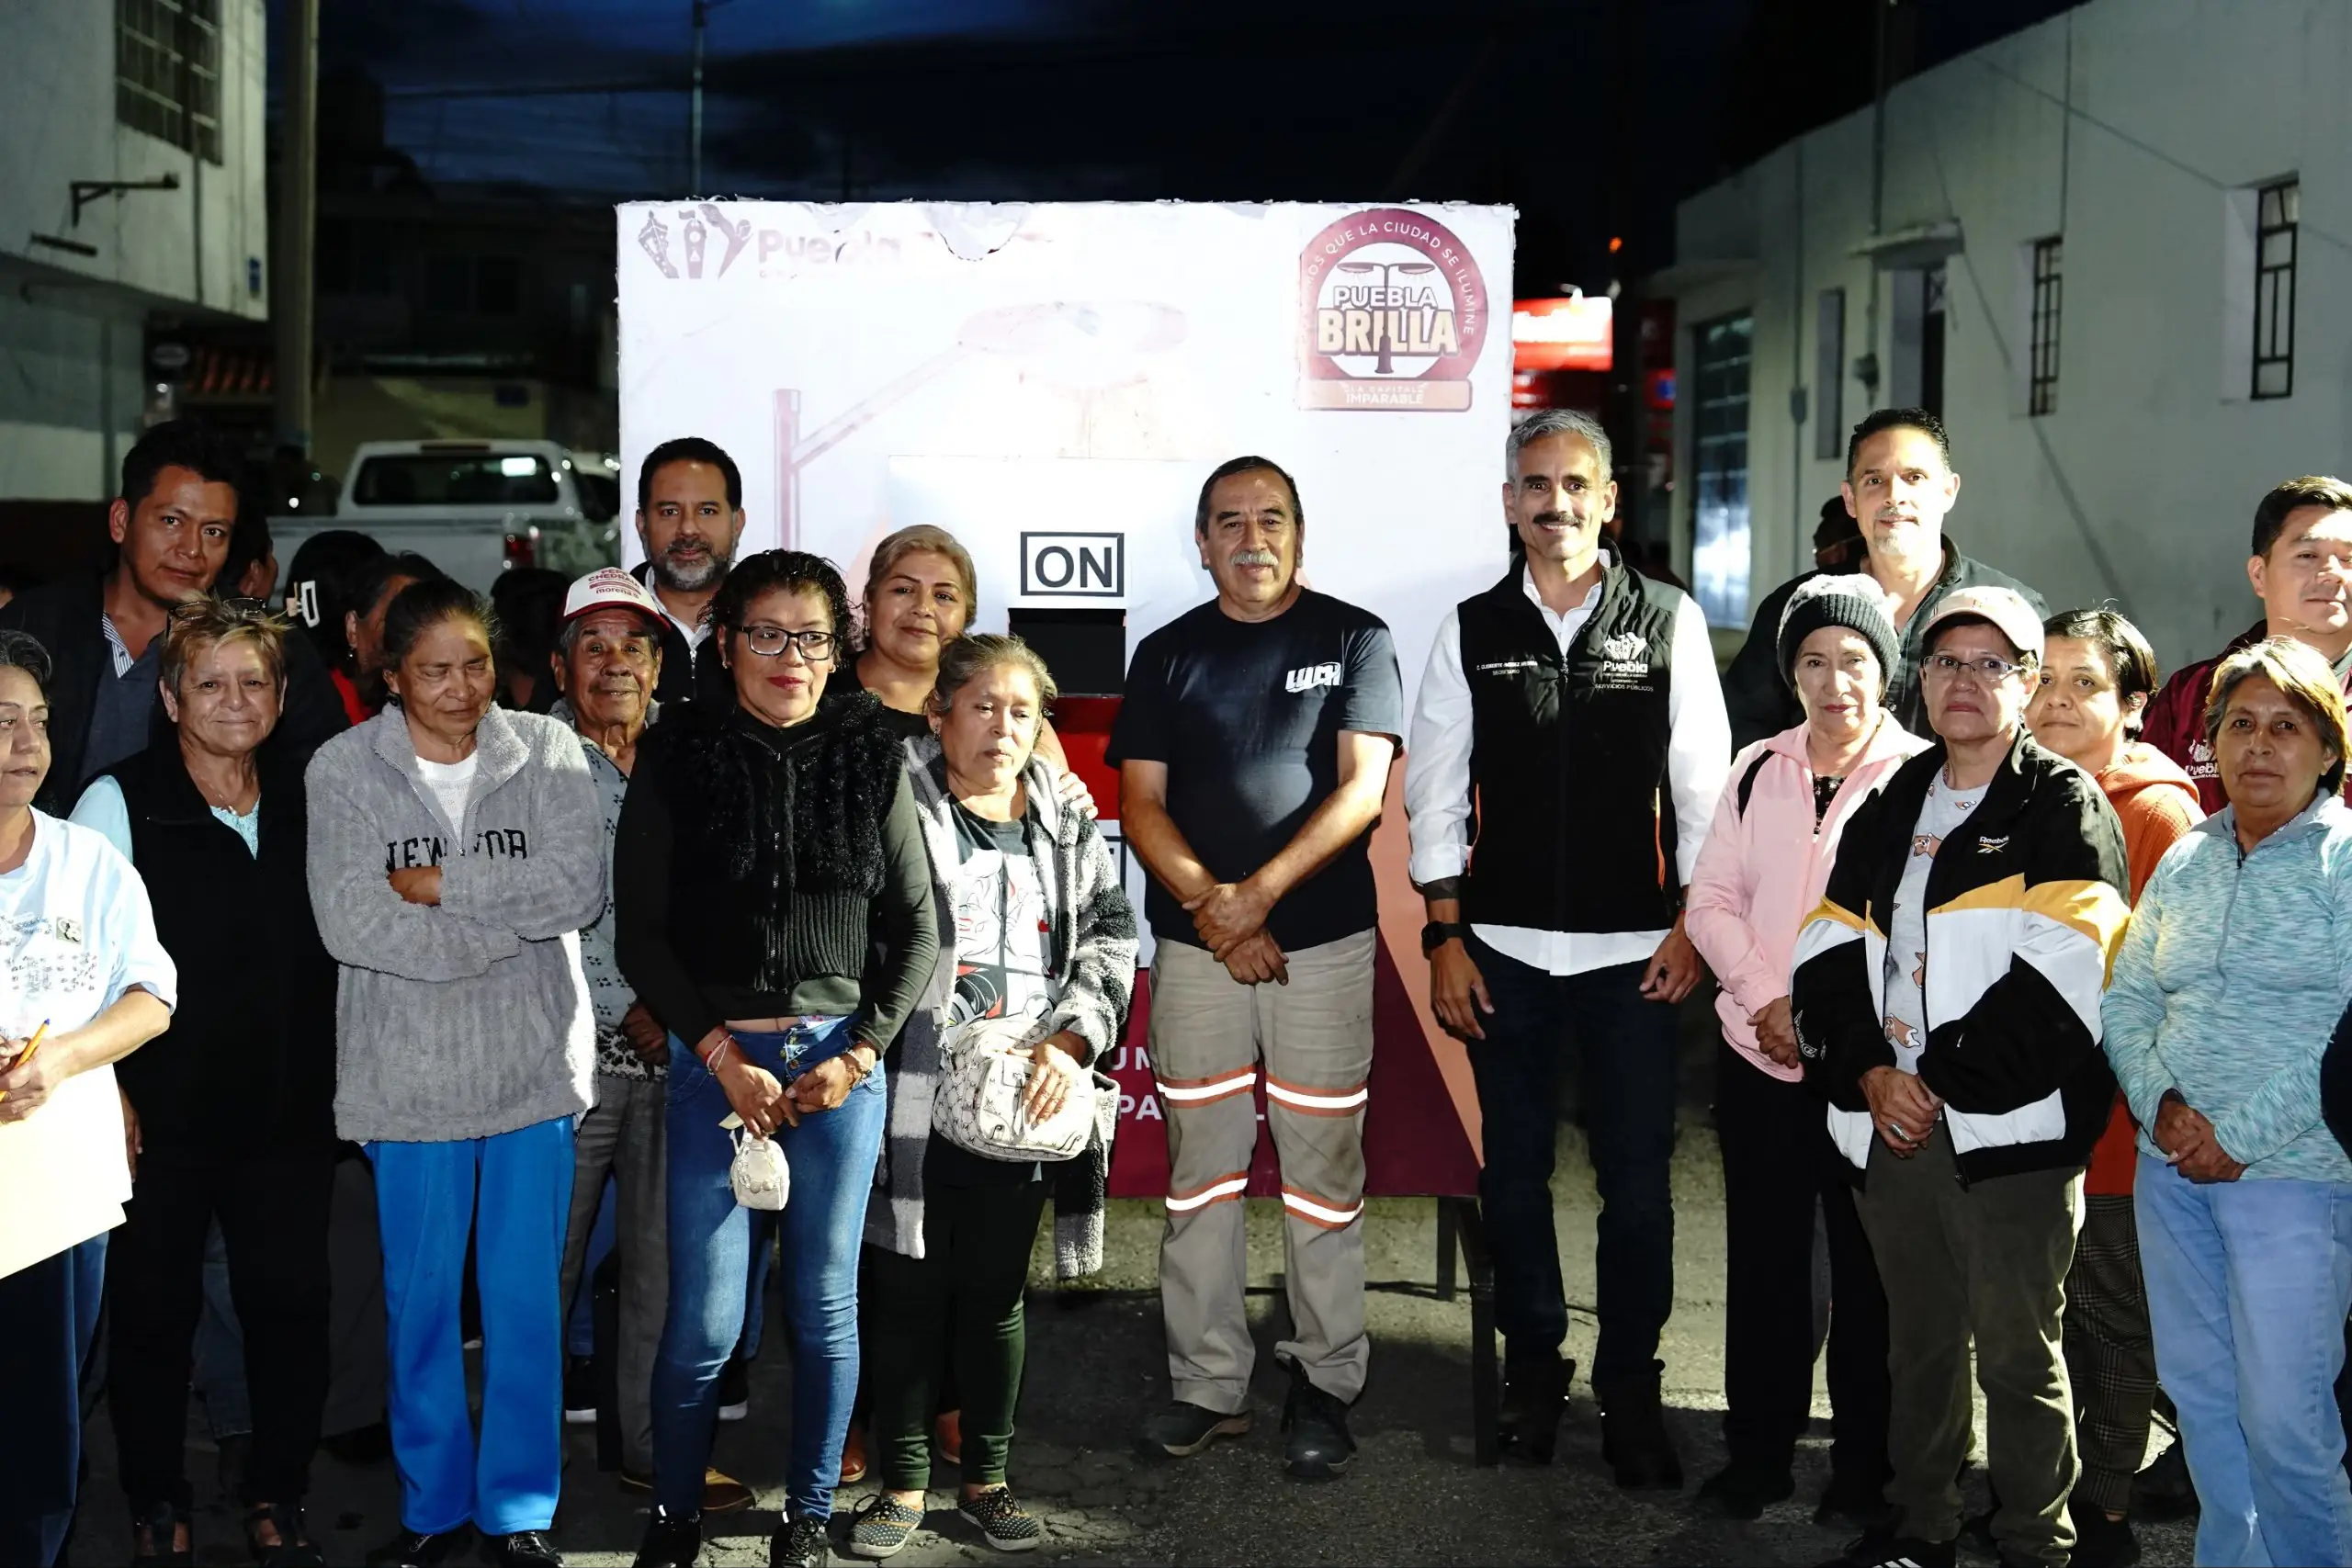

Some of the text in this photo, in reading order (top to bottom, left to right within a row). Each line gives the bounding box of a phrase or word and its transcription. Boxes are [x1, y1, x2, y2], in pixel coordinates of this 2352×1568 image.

[1326, 230, 1355, 254] QUE
[1360, 222, 1378, 236] LA
[1384, 221, 1441, 249] CIUDAD
[1442, 248, 1459, 266] SE
[1455, 268, 1475, 335] ILUMINE
[1334, 287, 1439, 308] PUEBLA
[1317, 309, 1460, 355] BRILLA
[1346, 393, 1424, 404] IMPARABLE
[1035, 546, 1112, 588] ON
[1603, 660, 1648, 673] Puebla
